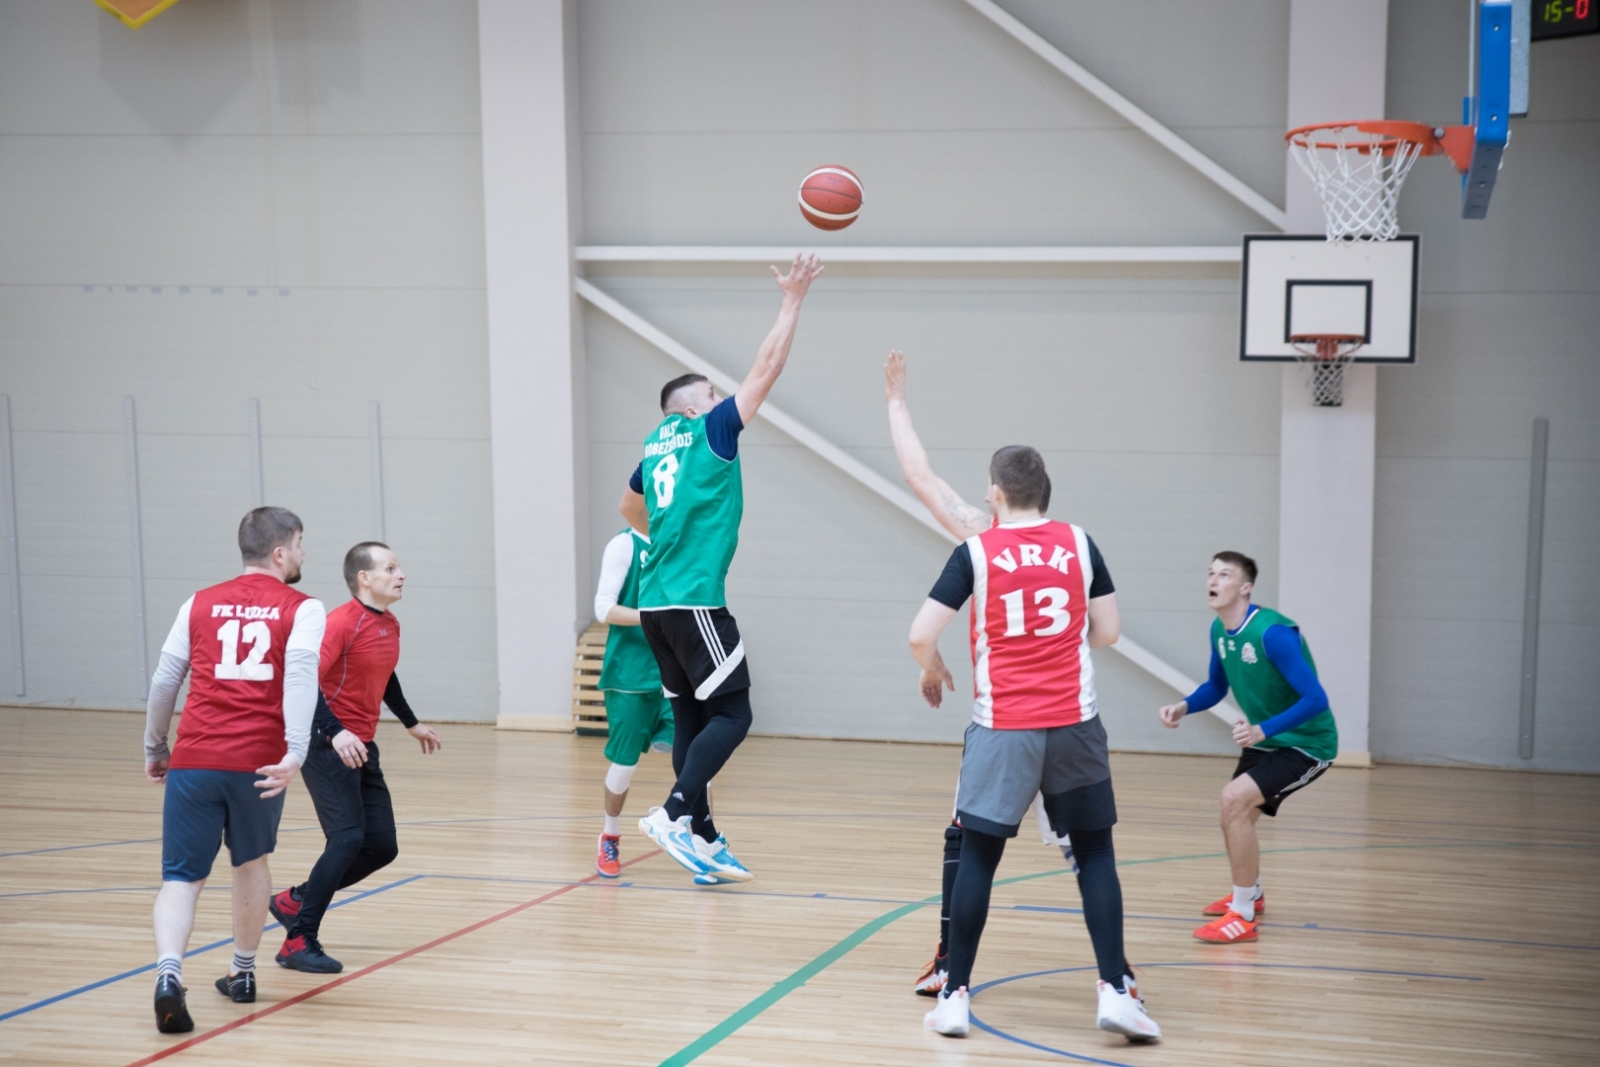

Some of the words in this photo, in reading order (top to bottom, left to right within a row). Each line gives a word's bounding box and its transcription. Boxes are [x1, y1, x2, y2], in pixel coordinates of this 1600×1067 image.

[652, 453, 679, 508] 8
[991, 543, 1076, 575] VRK
[211, 604, 235, 618] FK
[235, 604, 280, 620] LUDZA
[999, 586, 1071, 637] 13
[214, 619, 274, 681] 12
